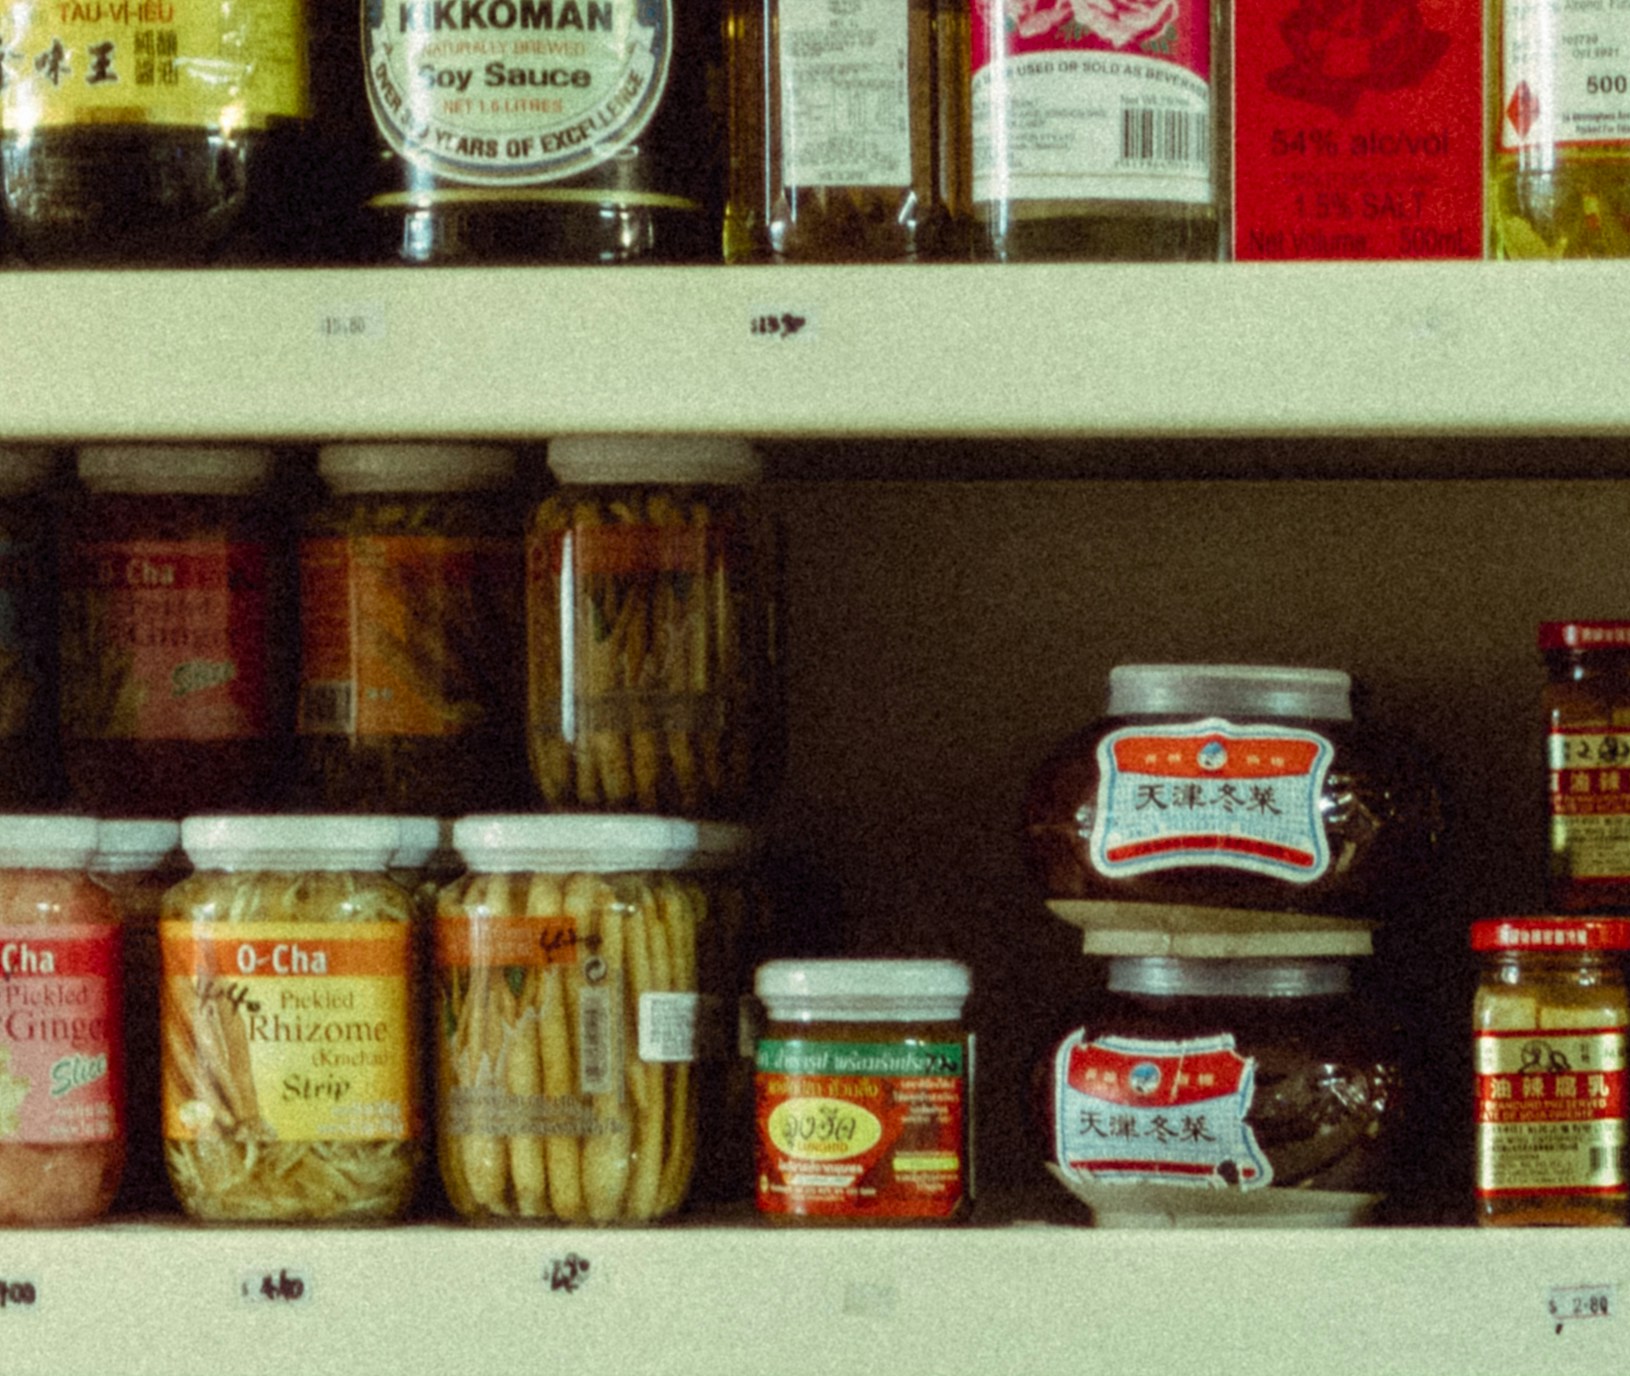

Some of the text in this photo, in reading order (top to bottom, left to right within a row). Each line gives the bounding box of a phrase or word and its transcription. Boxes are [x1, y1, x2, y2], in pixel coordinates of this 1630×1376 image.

[419, 61, 592, 92] Soy Sauce
[1017, 60, 1142, 77] USED OR SOLD AS
[1586, 75, 1629, 95] 500
[375, 62, 402, 112] OVER
[505, 137, 535, 159] OF
[443, 98, 563, 114] NET LITRES
[1270, 130, 1340, 158] 54%
[1361, 191, 1428, 221] SALT
[1249, 227, 1285, 255] Net
[1135, 783, 1283, 816] 天津冬菜
[2, 943, 55, 974] Cha
[236, 943, 328, 975] O-Cha
[280, 991, 354, 1009] Pickled
[248, 1016, 388, 1043] Rhizome
[281, 1074, 352, 1104] Strip
[1079, 1108, 1218, 1145] 天津冬菜
